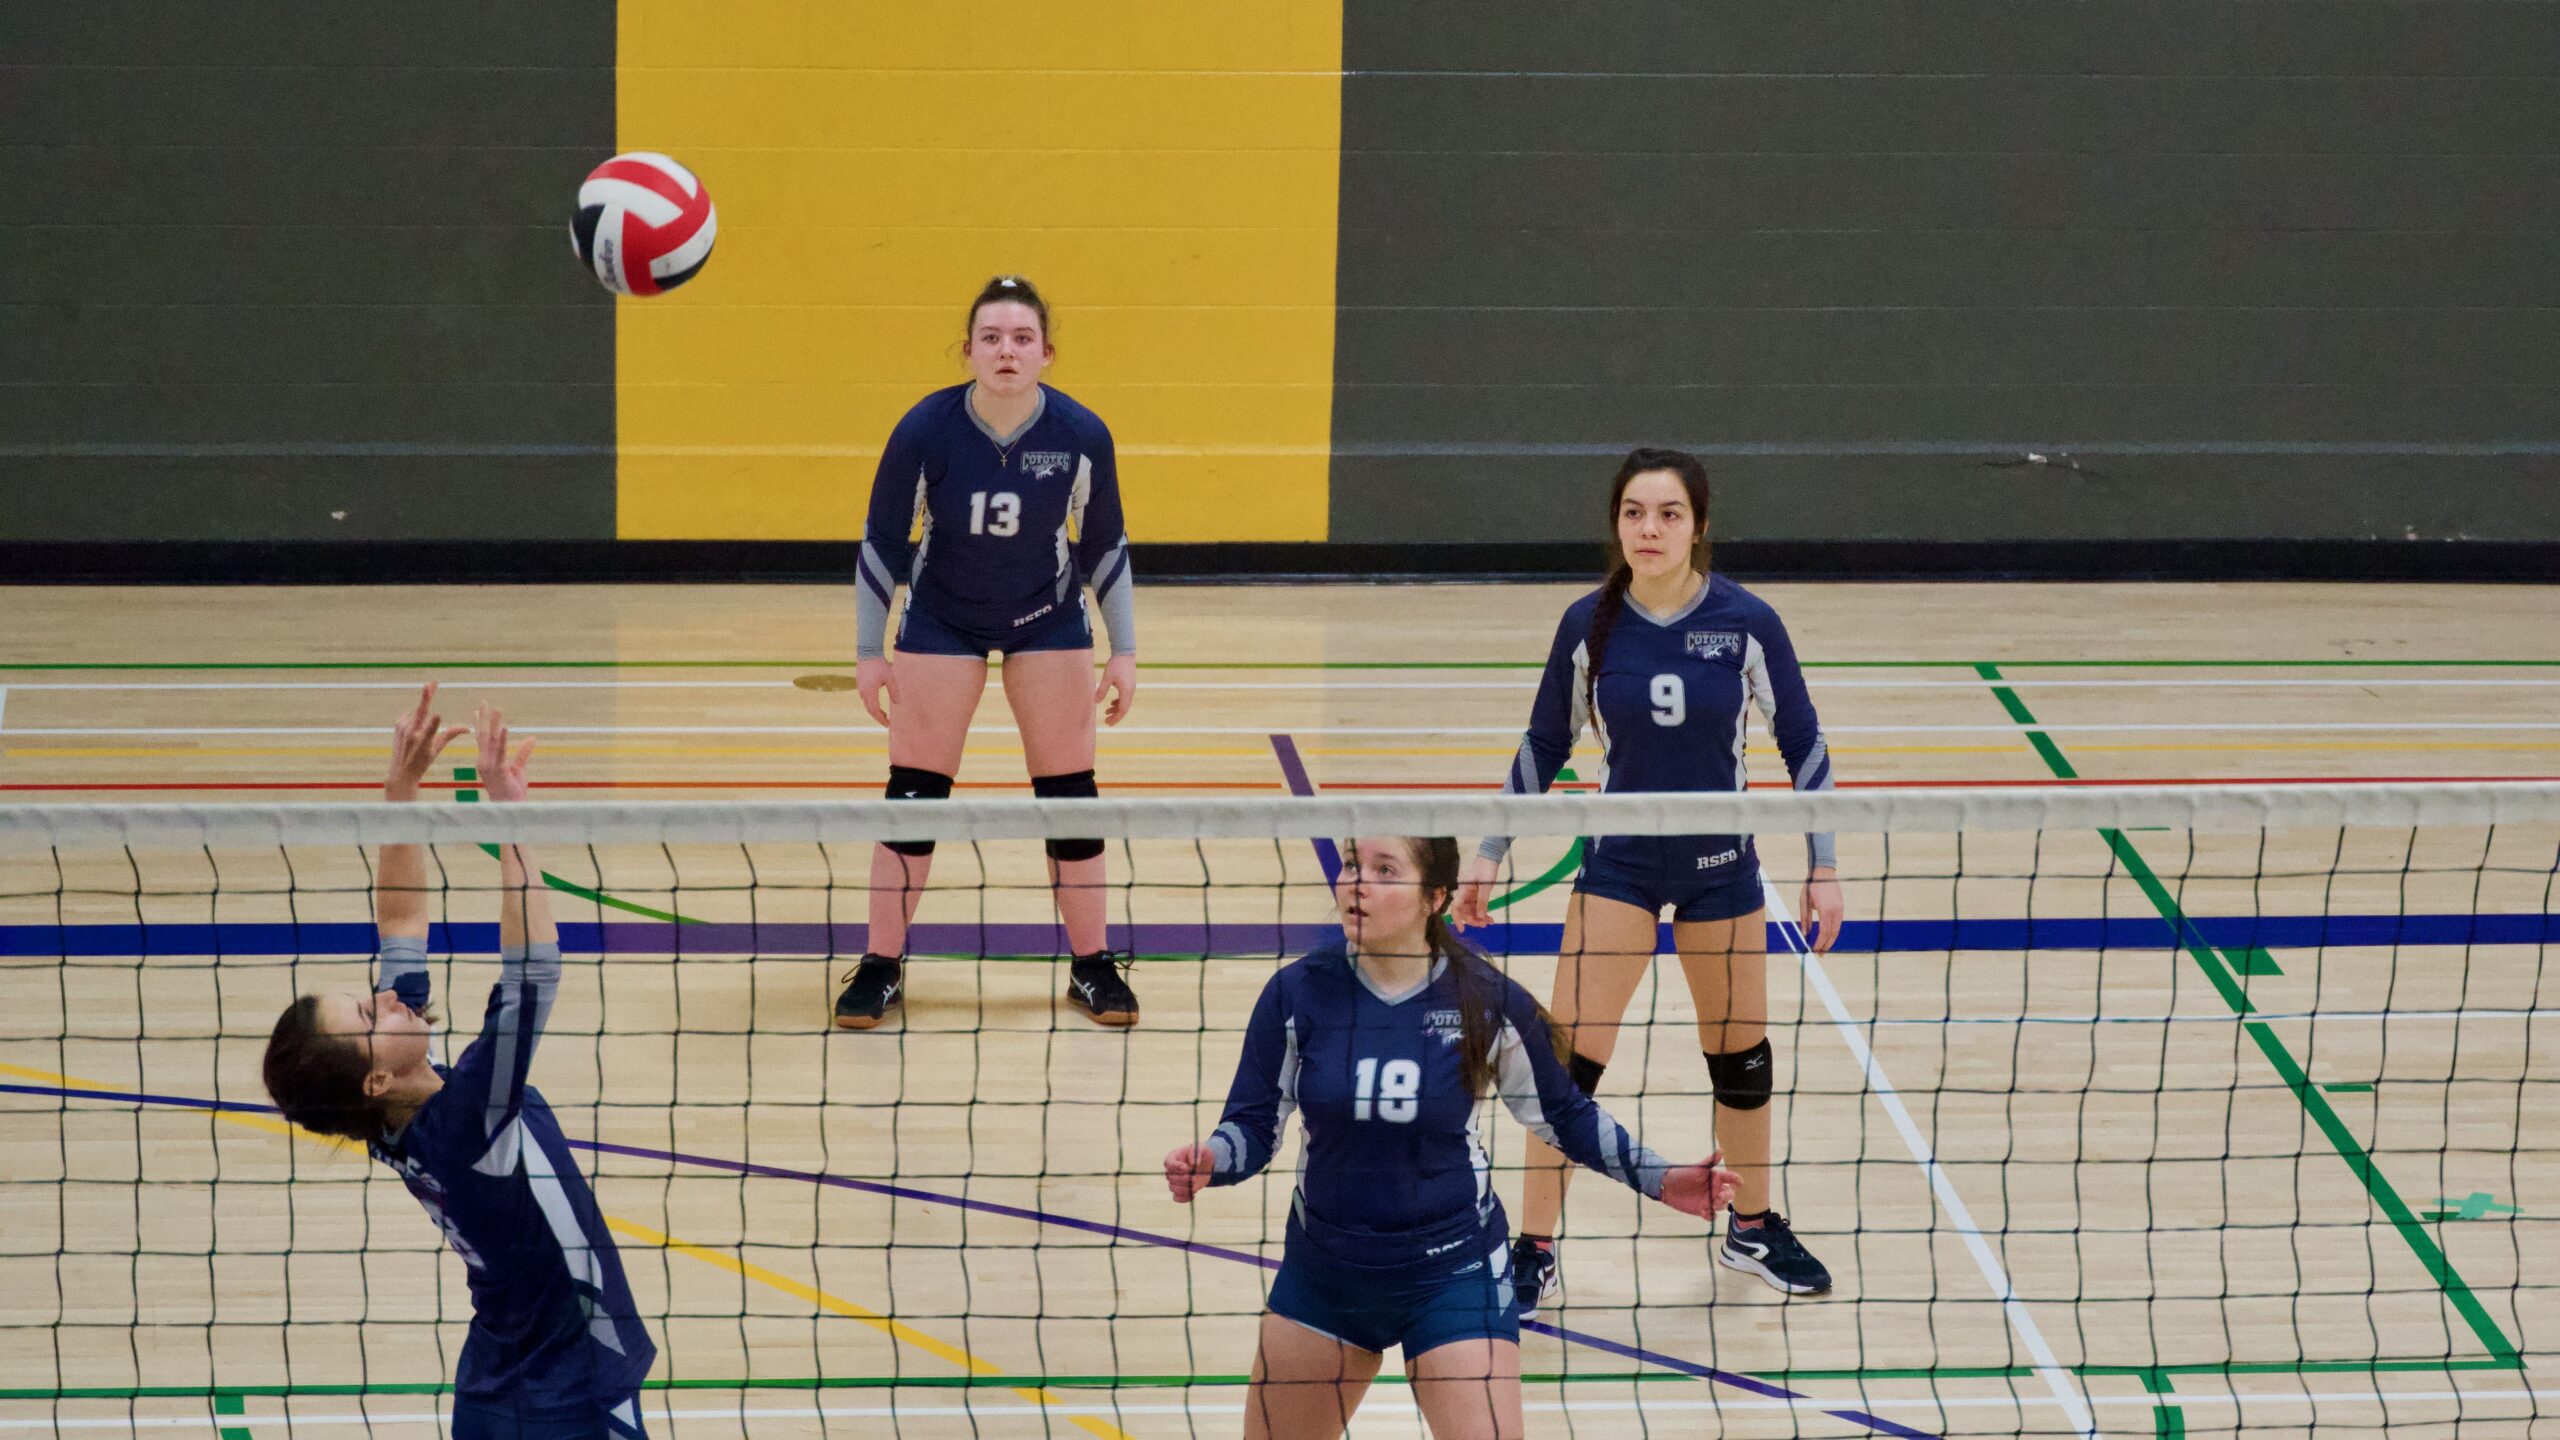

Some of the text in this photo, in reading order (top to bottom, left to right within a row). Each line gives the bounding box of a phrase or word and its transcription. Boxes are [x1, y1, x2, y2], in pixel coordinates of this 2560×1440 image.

[1021, 451, 1070, 472] COYOTES
[970, 491, 1021, 536] 13
[1686, 631, 1740, 654] COYOTES
[1650, 673, 1686, 727] 9
[1354, 1057, 1421, 1123] 18
